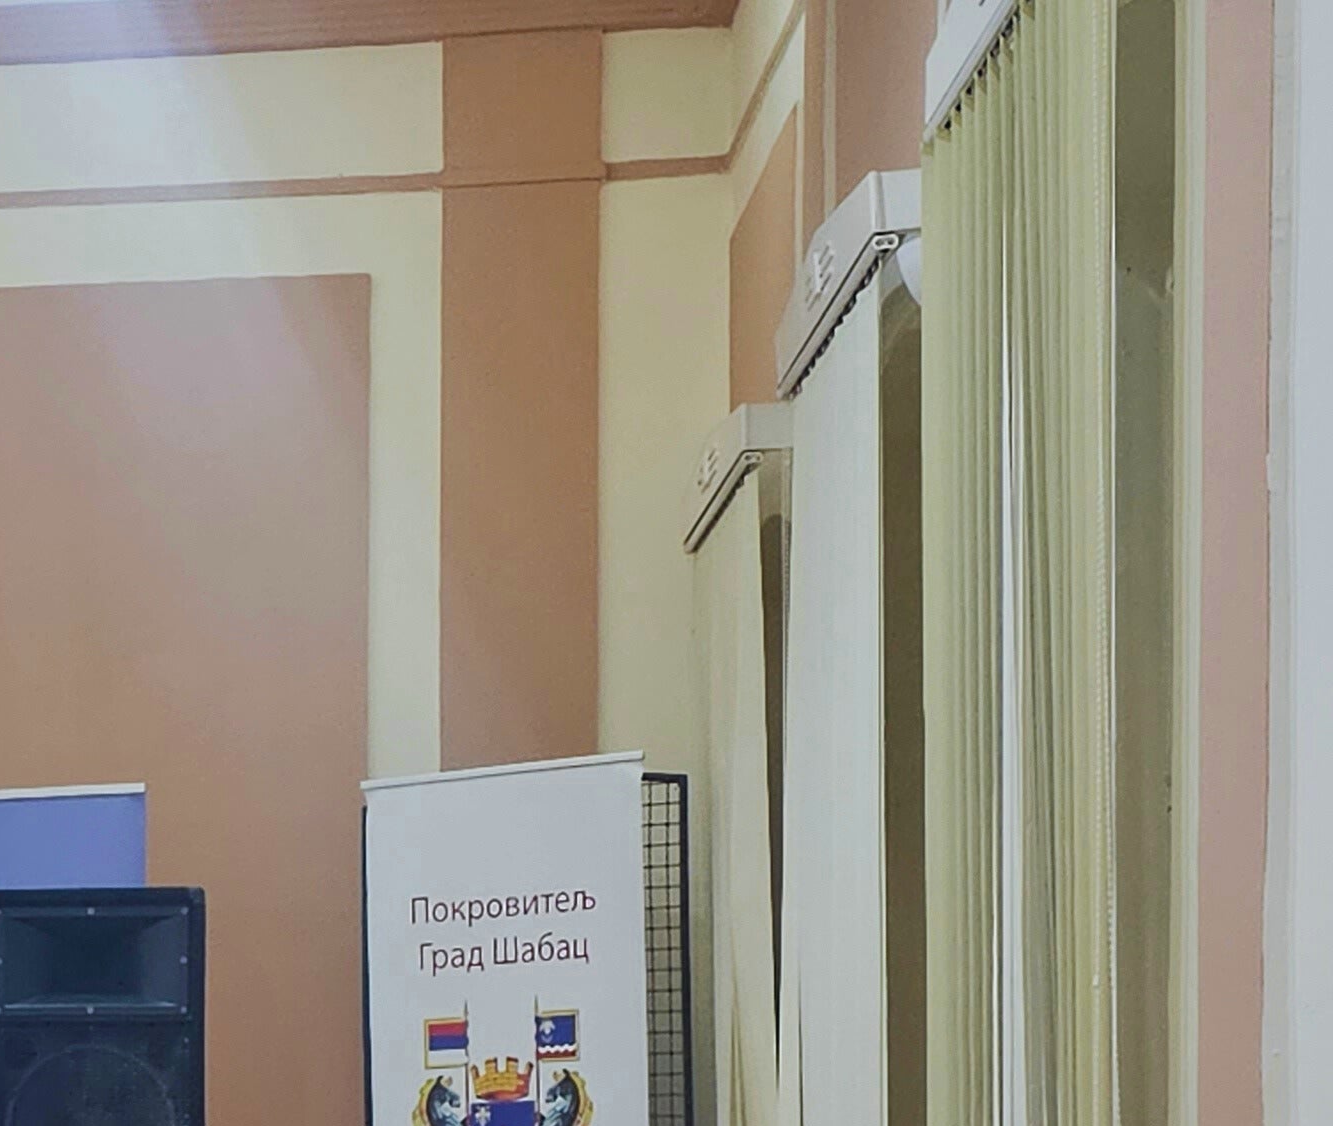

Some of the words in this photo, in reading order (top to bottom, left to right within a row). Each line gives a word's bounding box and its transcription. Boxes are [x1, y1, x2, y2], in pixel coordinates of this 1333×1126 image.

[410, 889, 597, 927] Покровитељ
[419, 942, 485, 977] Град
[492, 932, 590, 964] Шабац
